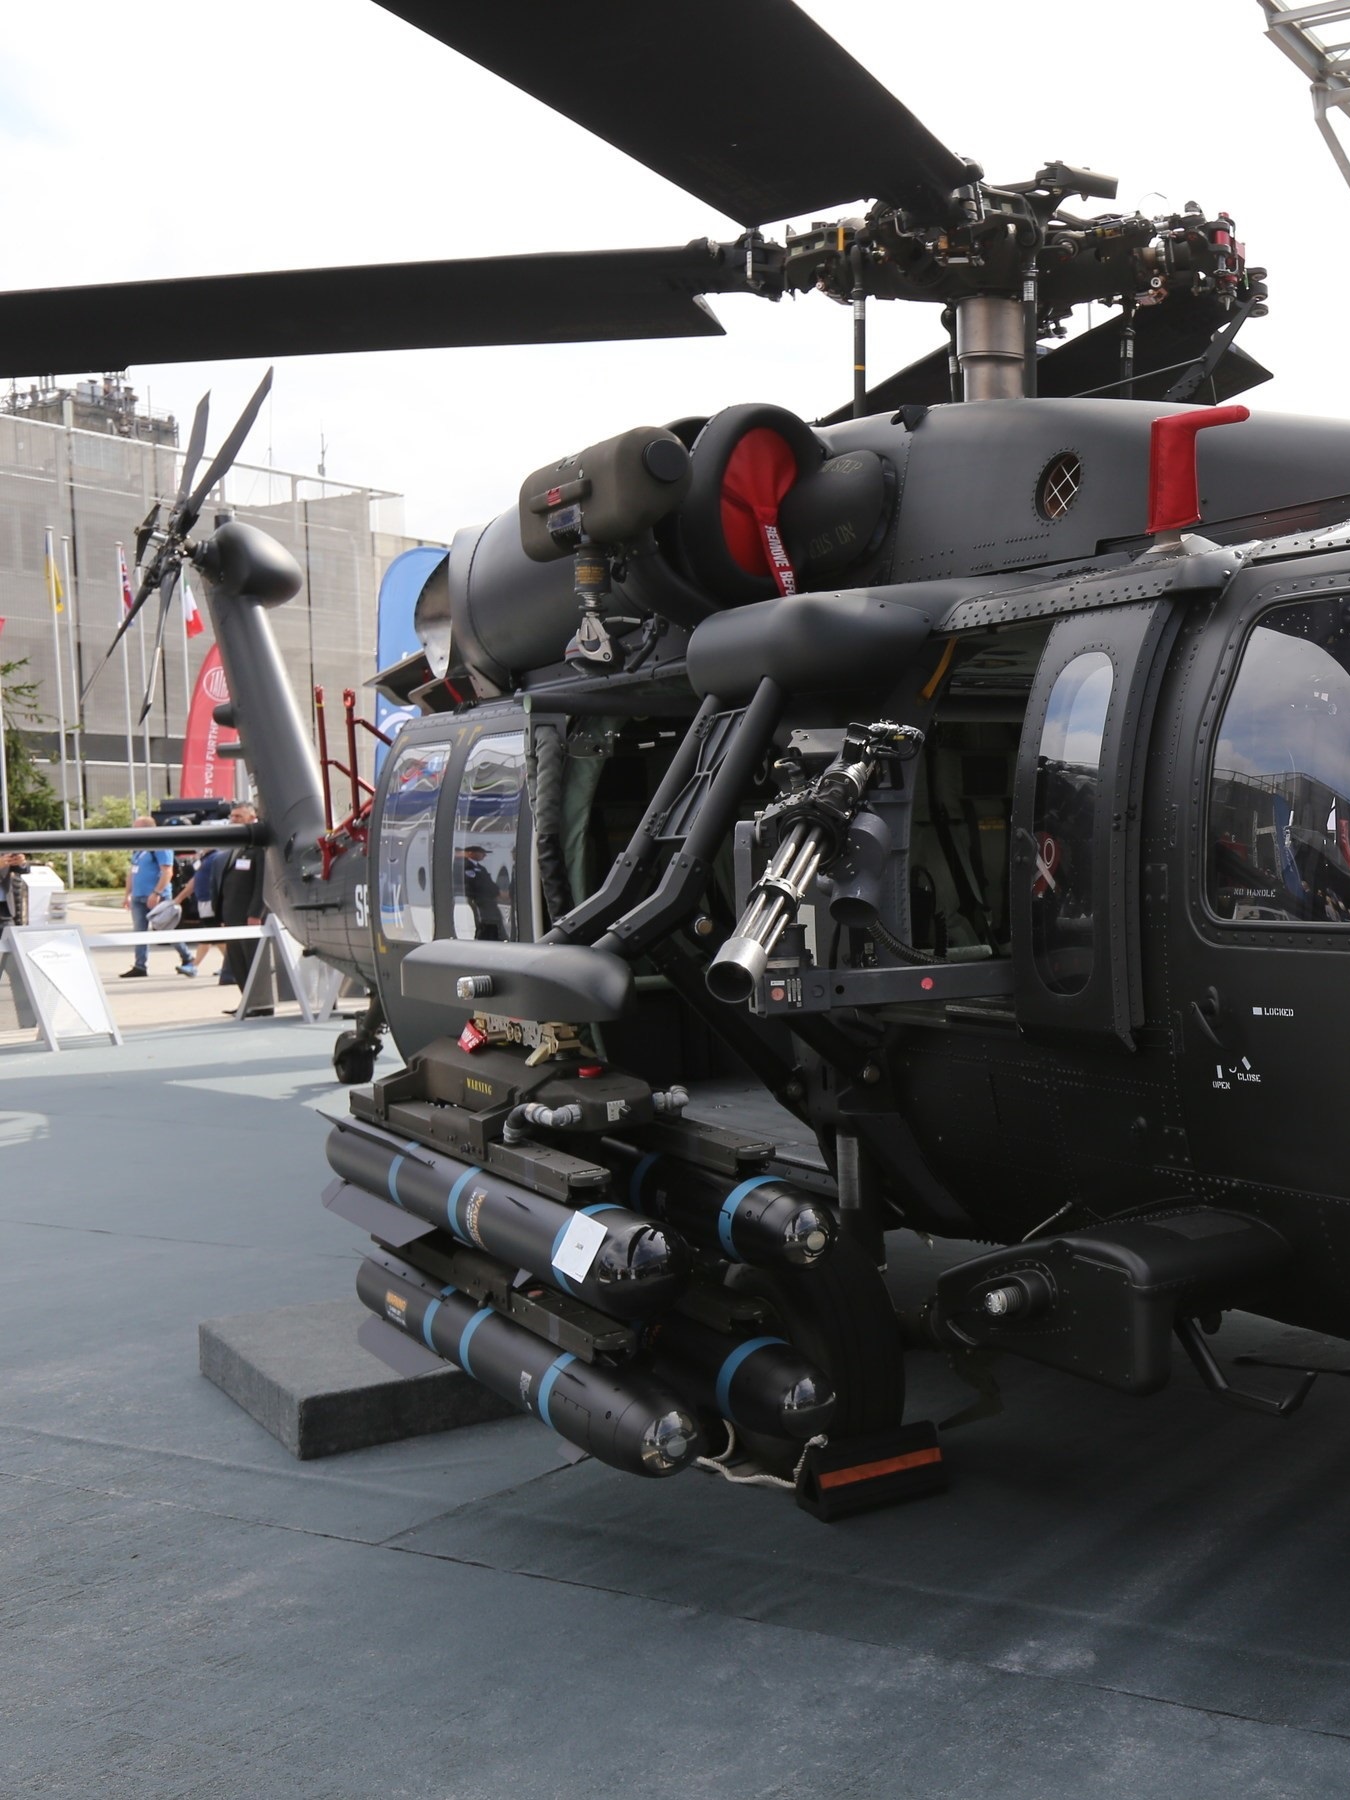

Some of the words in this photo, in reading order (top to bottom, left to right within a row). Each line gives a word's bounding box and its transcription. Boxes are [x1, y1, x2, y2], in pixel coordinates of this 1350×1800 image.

[764, 524, 790, 568] REMOVE
[204, 763, 215, 784] YOU
[1233, 887, 1244, 897] NO
[1246, 888, 1277, 898] HANDLE
[1264, 1007, 1294, 1017] LOCKED
[1237, 1072, 1262, 1083] CLOSE
[466, 1077, 493, 1096] WARNING
[1212, 1080, 1231, 1090] OPEN
